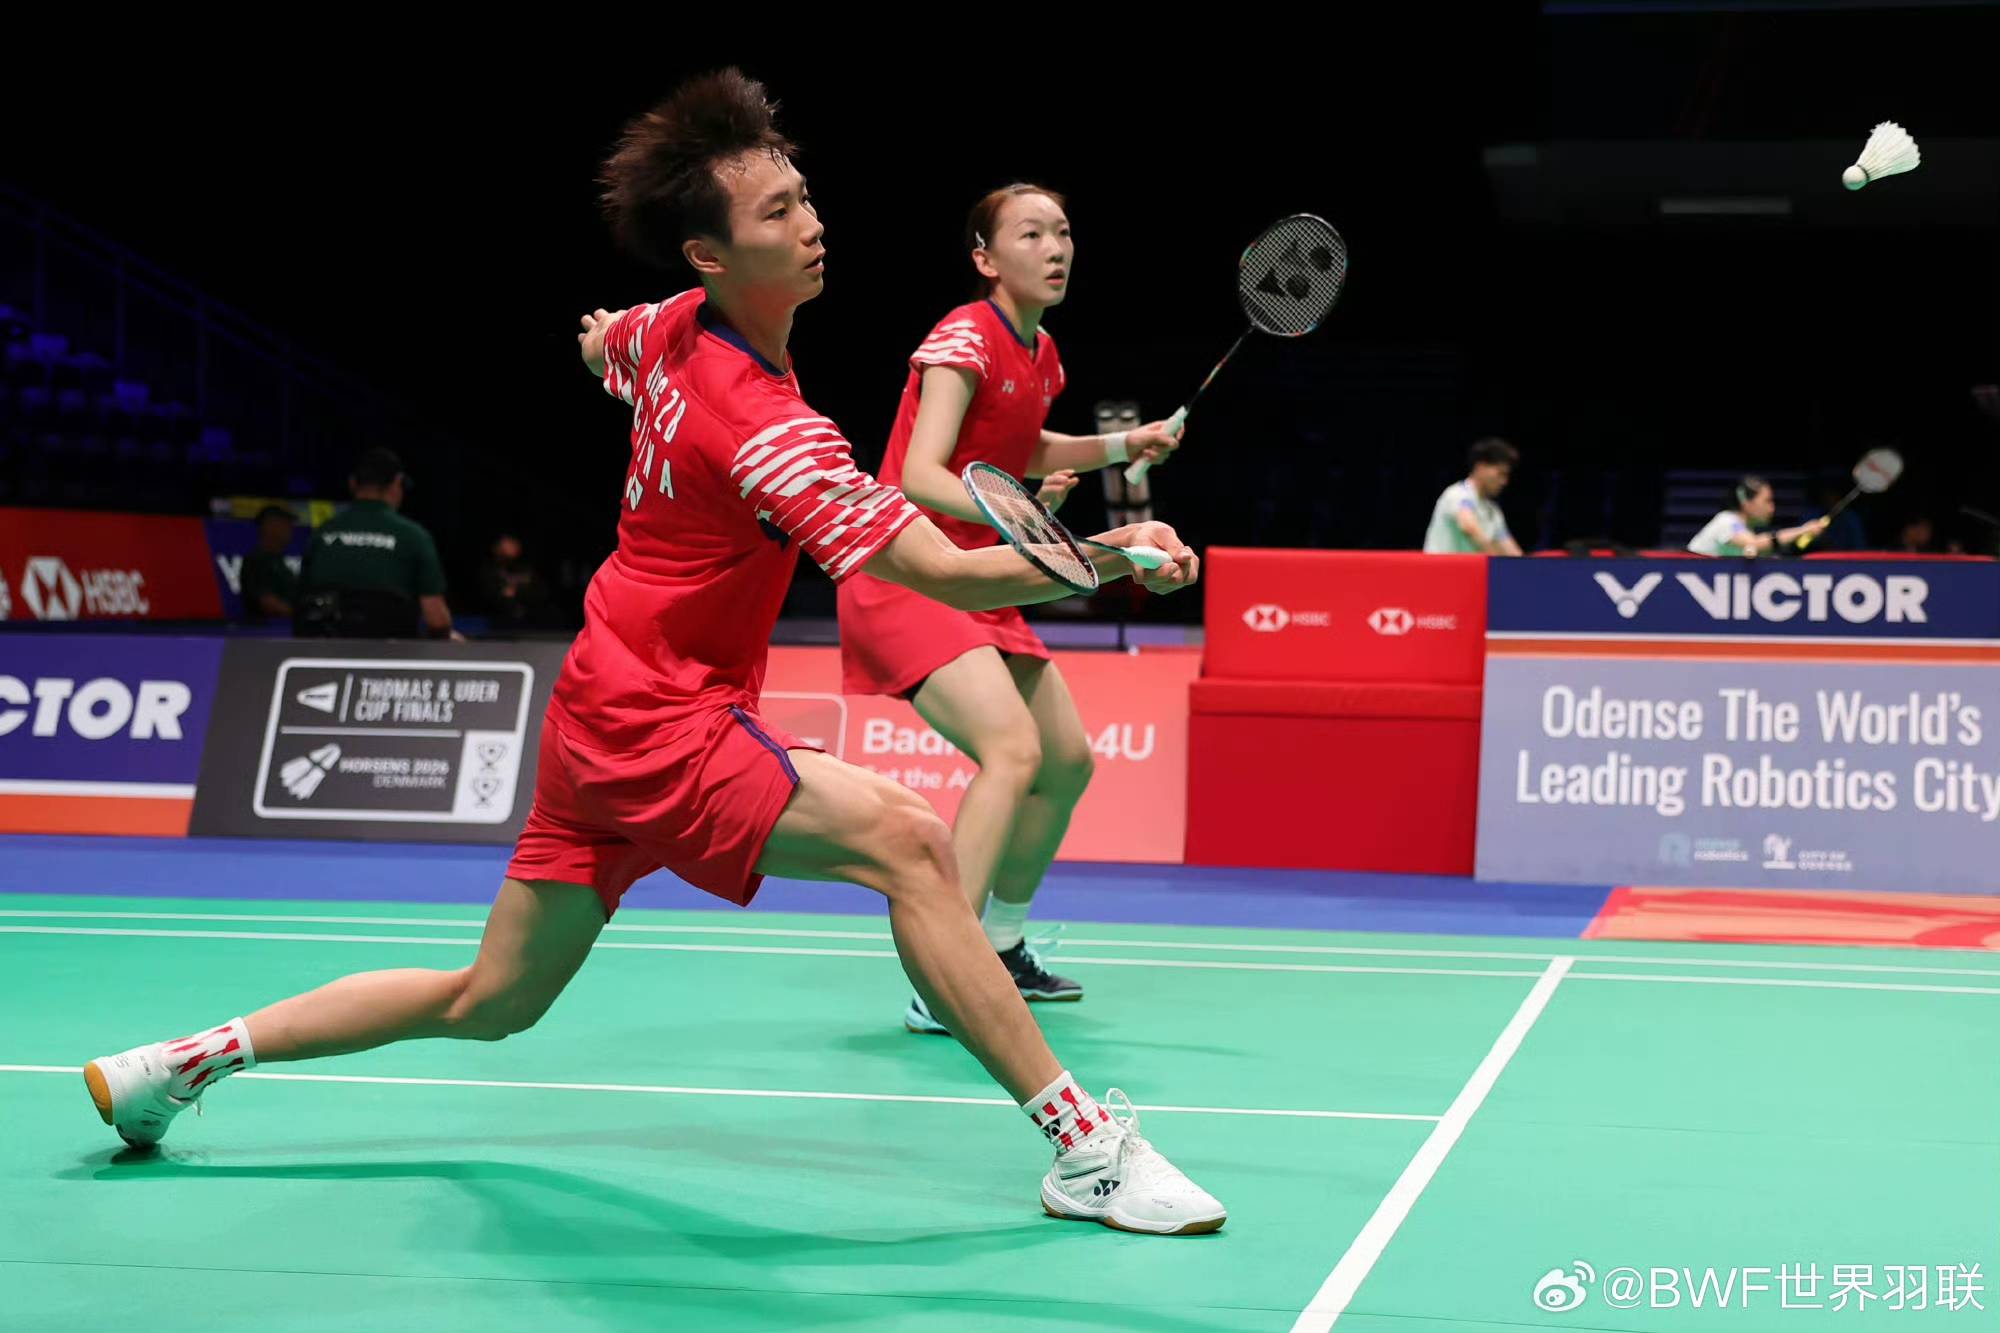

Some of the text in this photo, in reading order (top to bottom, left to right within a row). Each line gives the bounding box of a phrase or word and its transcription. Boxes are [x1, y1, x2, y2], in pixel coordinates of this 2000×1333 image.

[82, 569, 149, 615] HSBC
[1676, 572, 1929, 623] VICTOR
[354, 700, 455, 723] CUP FINALS
[360, 678, 499, 703] THOMAS & UBER
[1542, 685, 1982, 746] Odense The World's
[1516, 750, 2000, 822] Leading Robotics City
